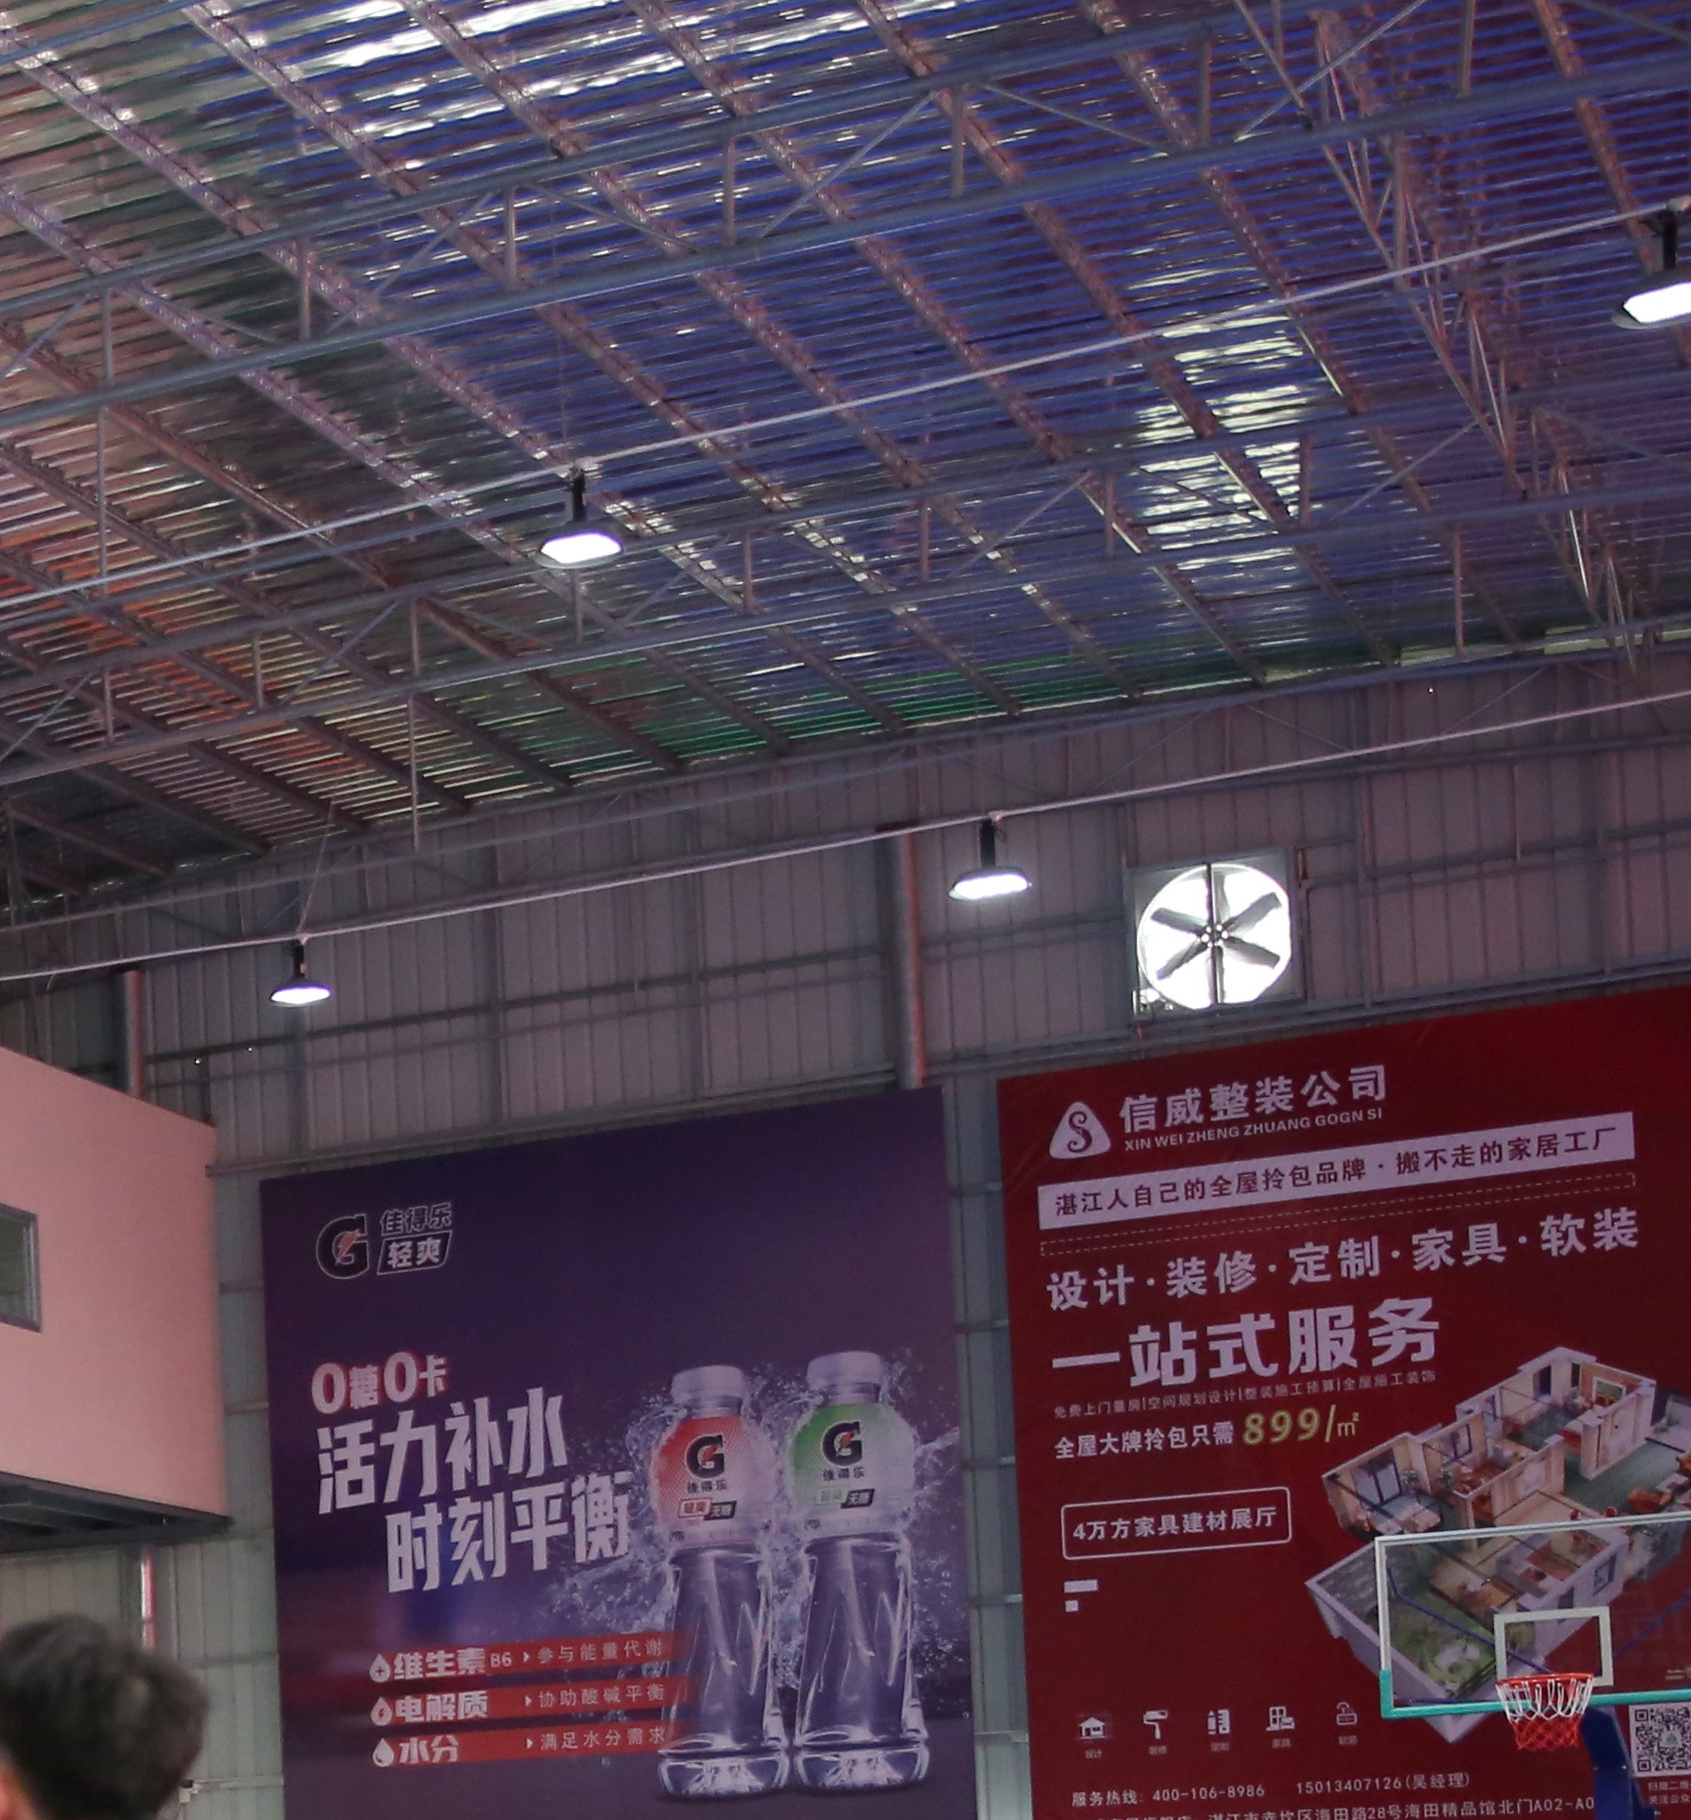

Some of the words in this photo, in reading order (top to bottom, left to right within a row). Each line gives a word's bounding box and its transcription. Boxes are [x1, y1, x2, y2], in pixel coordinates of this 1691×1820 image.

[1119, 1064, 1386, 1133] 信威整装公司
[1124, 1138, 1152, 1151] XIN
[1155, 1134, 1183, 1147] WEI
[1187, 1126, 1239, 1144] ZHENG
[1244, 1118, 1310, 1136] ZHUANG
[1315, 1112, 1363, 1128] GOGN
[1367, 1109, 1382, 1121] SI
[380, 1202, 452, 1237] 佳得乐
[387, 1238, 442, 1269] 轻爽
[1051, 1297, 1441, 1388] 一站式服务
[317, 1387, 567, 1515] 活力补水
[1054, 1421, 1235, 1460] 全屋大牌拎包只需
[385, 1471, 633, 1593] 时刻平衡
[1072, 1505, 1278, 1542] 4万方家具建材展厅
[393, 1648, 486, 1680] 维生素
[490, 1654, 512, 1668] B6
[537, 1638, 662, 1665] 参与能量代谢
[395, 1690, 489, 1722] 电解质
[538, 1684, 665, 1709] 协助酸碱平衡
[399, 1735, 459, 1764] 水分
[541, 1726, 666, 1751] 满足水分需求
[1153, 1784, 1265, 1801] 400-106-8986
